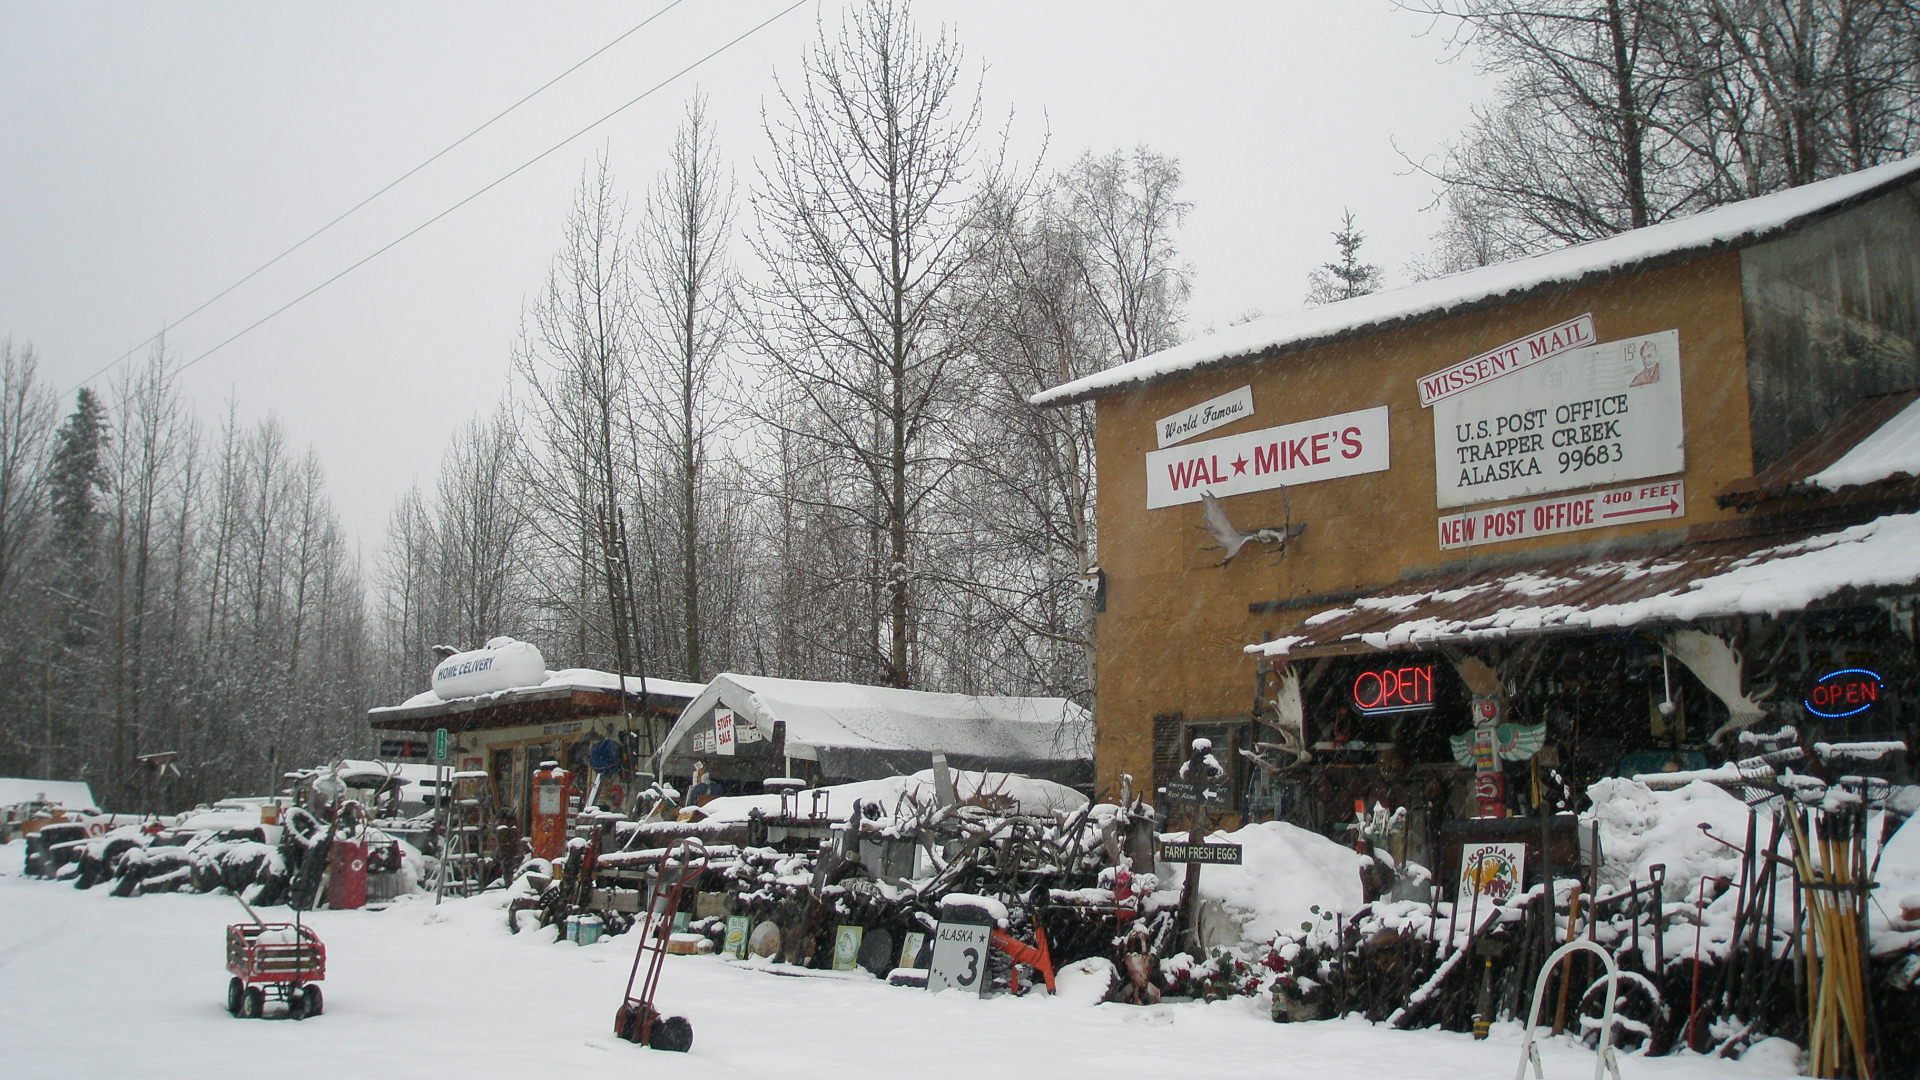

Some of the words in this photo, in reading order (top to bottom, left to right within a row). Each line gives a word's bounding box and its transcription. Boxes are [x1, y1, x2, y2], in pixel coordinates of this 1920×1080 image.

[1423, 347, 1521, 400] MISSENT
[1527, 322, 1589, 359] MAIL
[1165, 414, 1198, 439] World
[1202, 400, 1243, 424] Famous
[1456, 420, 1492, 442] U.S.
[1496, 409, 1547, 435] POST
[1555, 394, 1629, 425] OFFICE
[1457, 434, 1544, 464] TRAPPER
[1552, 420, 1621, 448] CREEK
[1168, 455, 1228, 491] WAL
[1254, 426, 1363, 476] MIKE'S
[1457, 457, 1542, 487] ALASKA
[1558, 443, 1623, 473] 99683
[1602, 491, 1632, 505] 400
[1640, 483, 1680, 499] FEET
[1441, 517, 1476, 546] NEW
[1484, 509, 1526, 538] POST
[1534, 499, 1594, 531] OFFICE
[438, 665, 457, 680] HOME
[1354, 665, 1432, 708] OPEN
[1812, 682, 1876, 705] OPEN
[717, 714, 732, 731] STUFF
[718, 730, 732, 746] SALE
[437, 731, 445, 757] 115
[1164, 846, 1186, 859] FARM
[1188, 846, 1214, 860] FRESH
[1216, 848, 1238, 860] EGGS
[1467, 846, 1516, 864] KODIAK
[939, 928, 973, 942] ALASKA
[956, 947, 979, 986] 3
